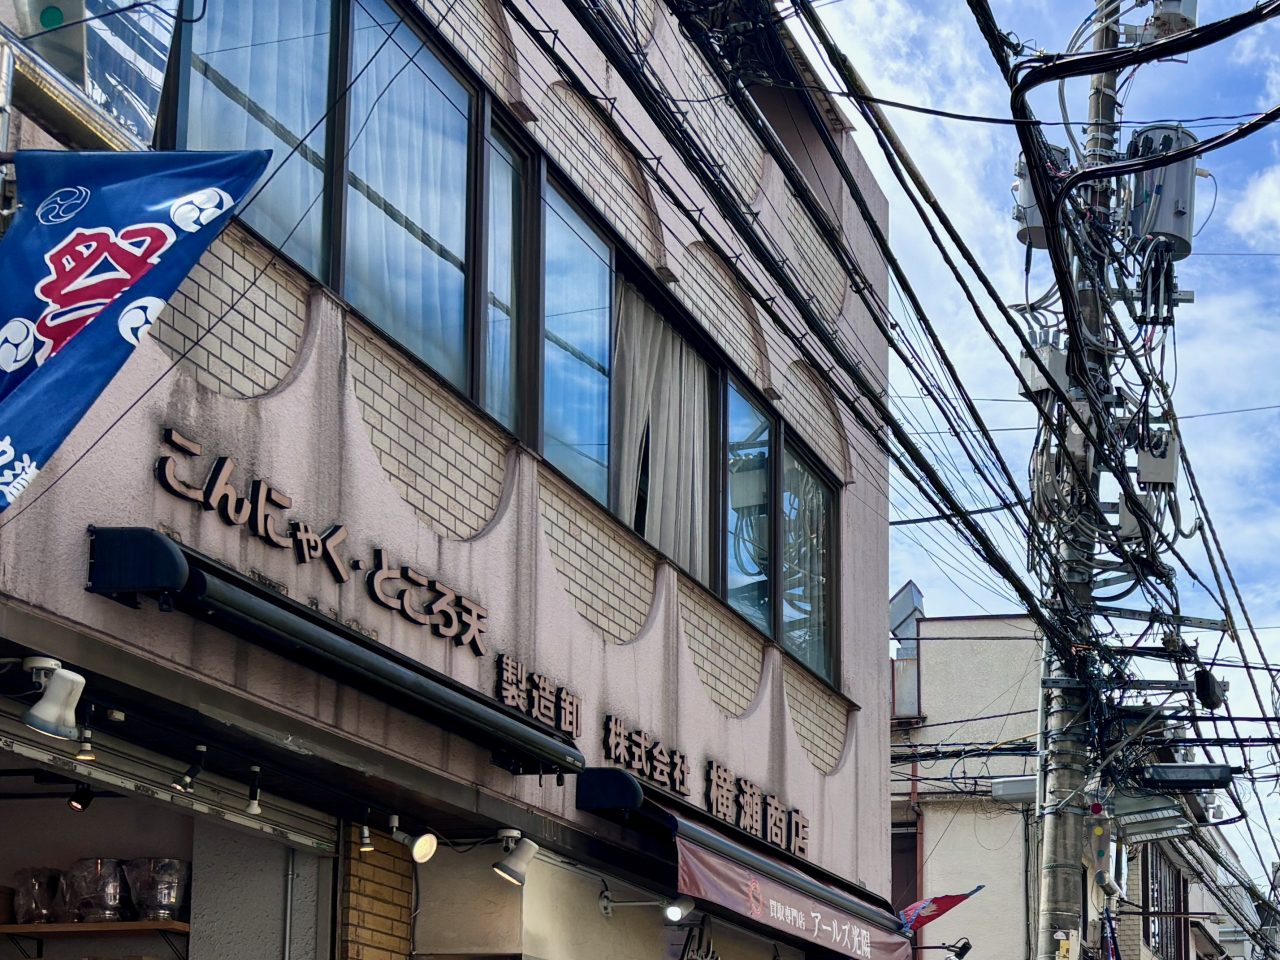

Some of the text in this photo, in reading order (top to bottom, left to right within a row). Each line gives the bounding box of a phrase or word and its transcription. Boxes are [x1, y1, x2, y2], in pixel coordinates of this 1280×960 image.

[496, 653, 582, 738] 製造卸
[605, 714, 691, 796] 株式会社
[707, 760, 810, 857] 横瀬商店
[811, 911, 871, 959] アールズ光陽
